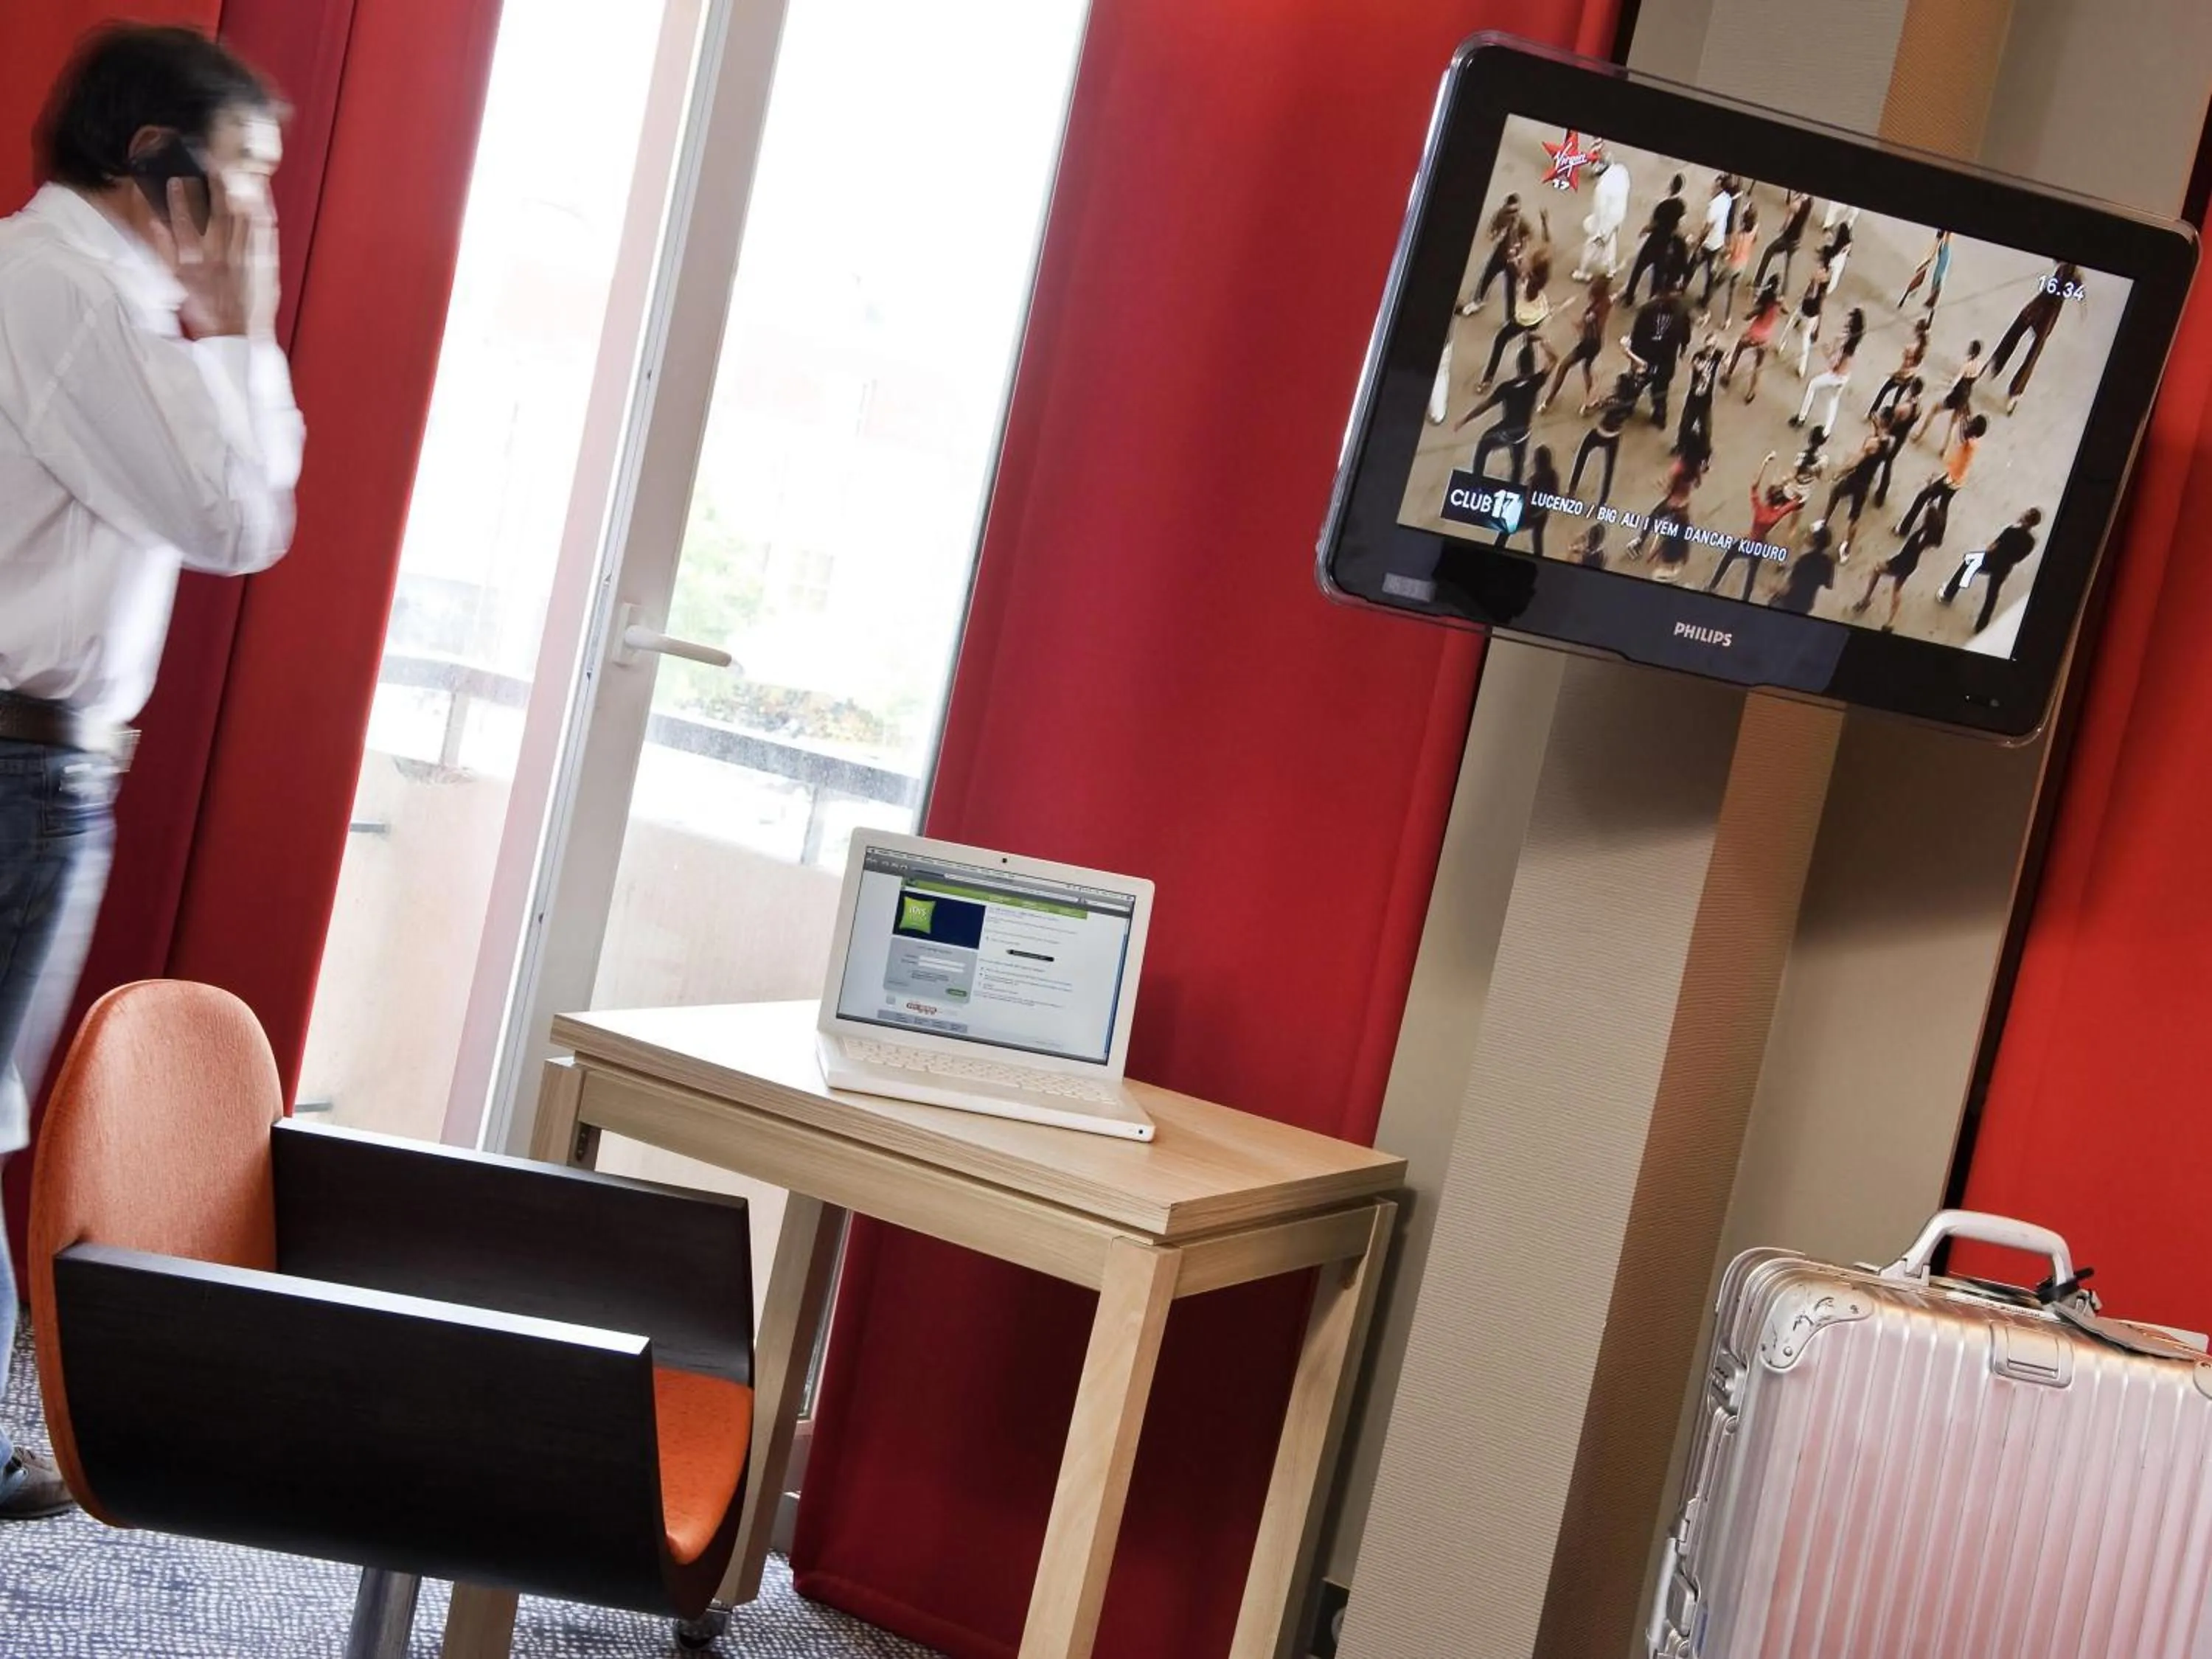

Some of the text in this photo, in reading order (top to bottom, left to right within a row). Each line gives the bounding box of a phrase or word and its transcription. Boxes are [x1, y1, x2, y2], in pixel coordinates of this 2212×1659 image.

[2038, 275, 2085, 302] 16.34
[1531, 490, 1583, 515] LUCENZO
[1597, 507, 1617, 523] BIG
[1621, 512, 1641, 529] ALI
[1654, 519, 1679, 538] VEM
[1684, 526, 1733, 549] DANCAR
[1738, 539, 1787, 561] KUDURO
[1674, 622, 1732, 647] PHILIPS
